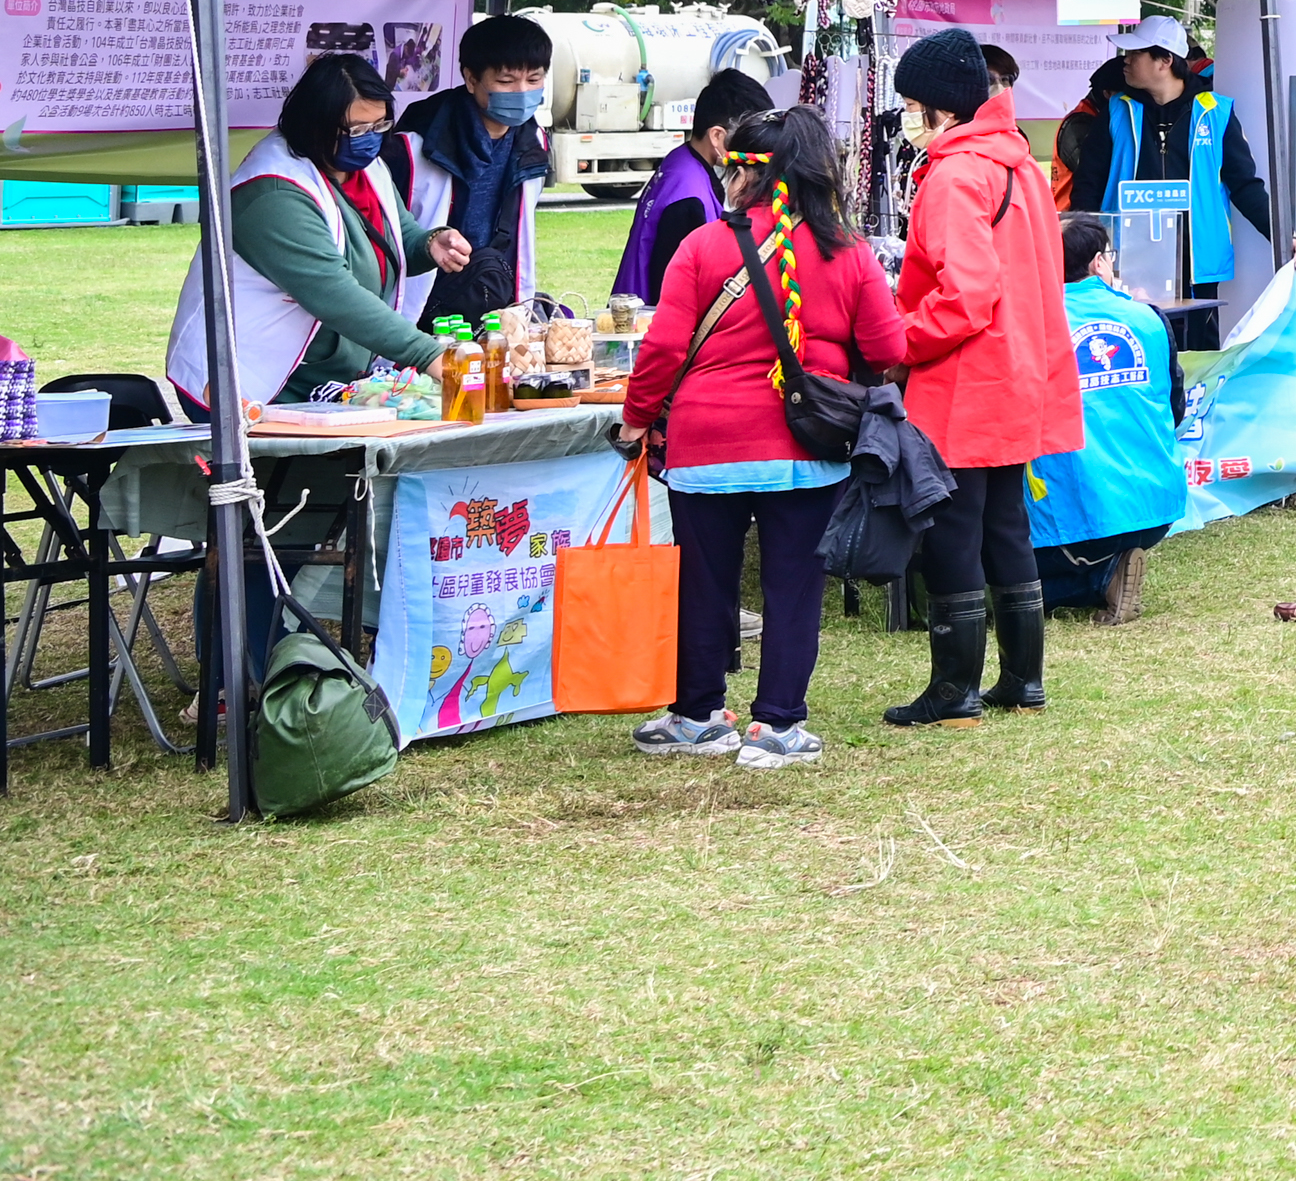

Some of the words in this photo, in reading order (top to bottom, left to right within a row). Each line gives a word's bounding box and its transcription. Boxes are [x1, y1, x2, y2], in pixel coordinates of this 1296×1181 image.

[1195, 138, 1212, 146] TXC
[1124, 189, 1154, 203] TXC
[1156, 189, 1187, 198] 台灣晶技
[465, 497, 531, 557] 築夢
